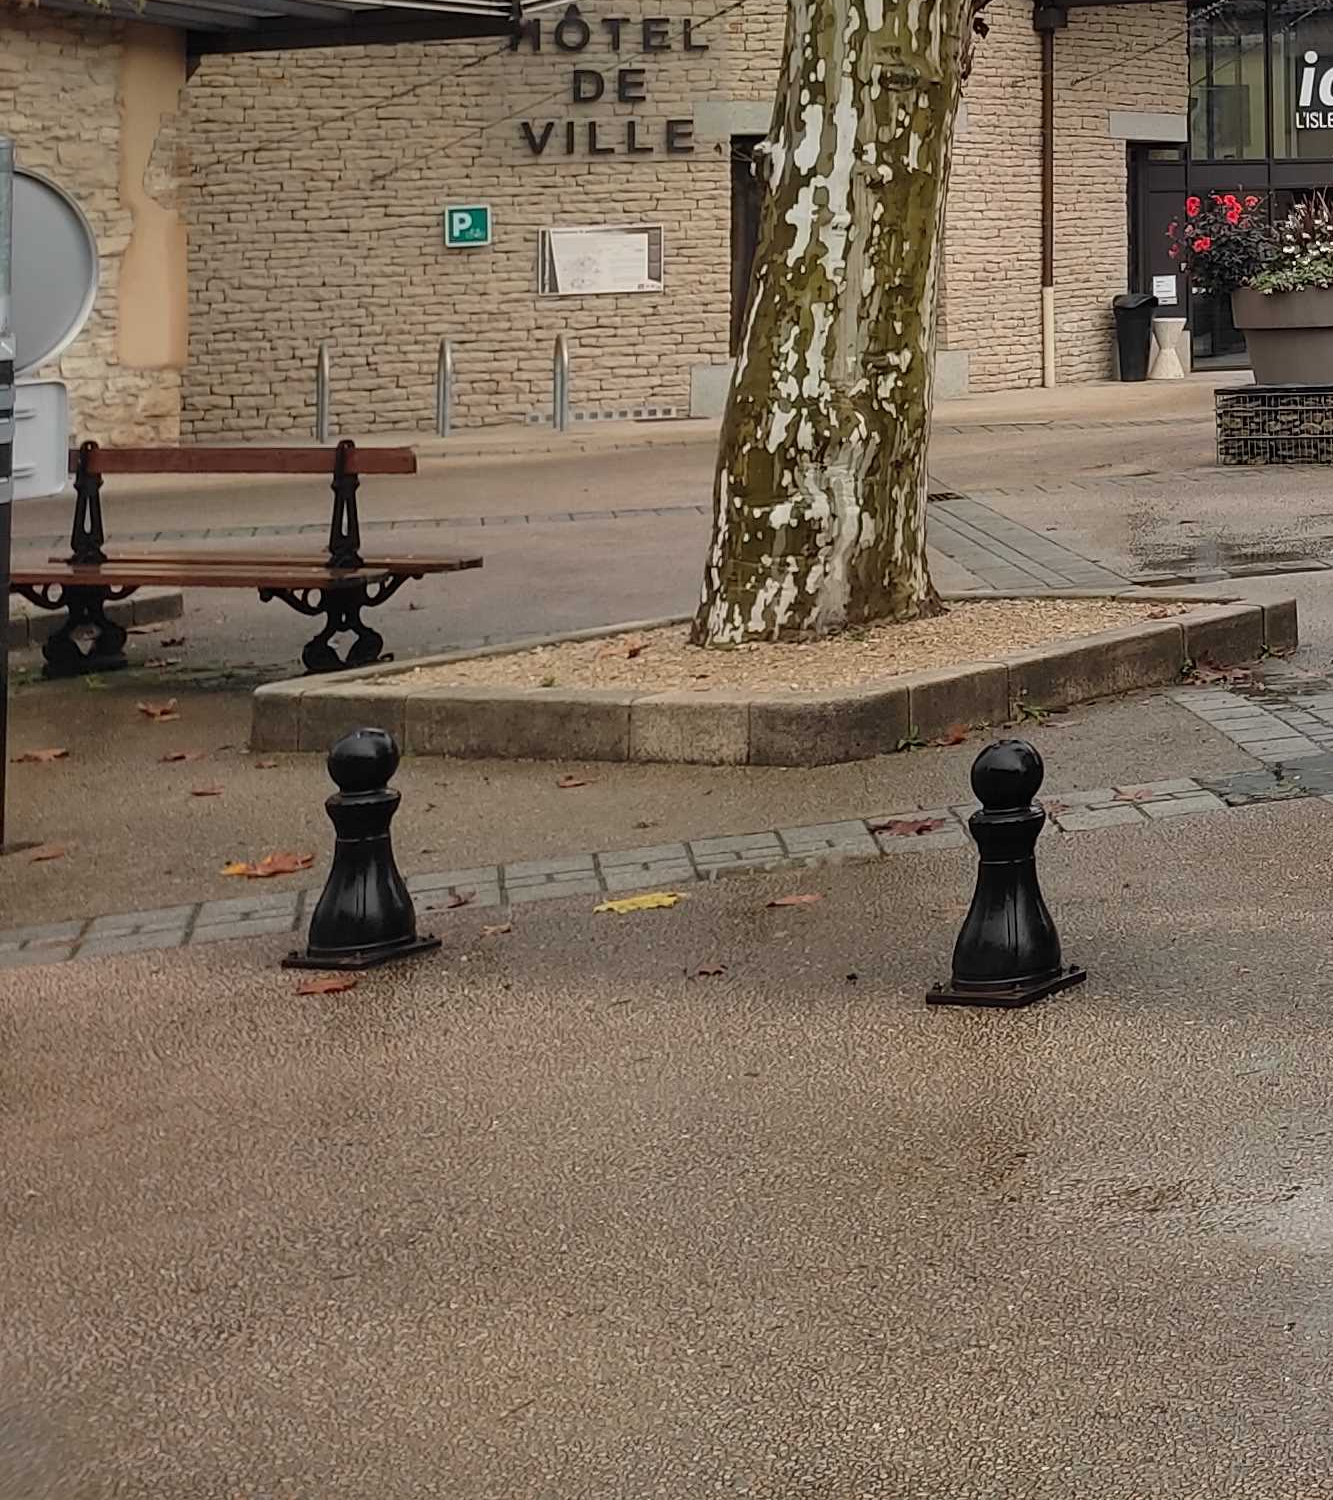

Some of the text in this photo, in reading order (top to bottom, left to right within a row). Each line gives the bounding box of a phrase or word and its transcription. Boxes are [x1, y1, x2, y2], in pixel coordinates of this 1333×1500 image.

[511, 4, 709, 51] HÔTEL
[573, 68, 647, 103] DE
[520, 119, 695, 155] VILLE
[452, 211, 473, 238] P
